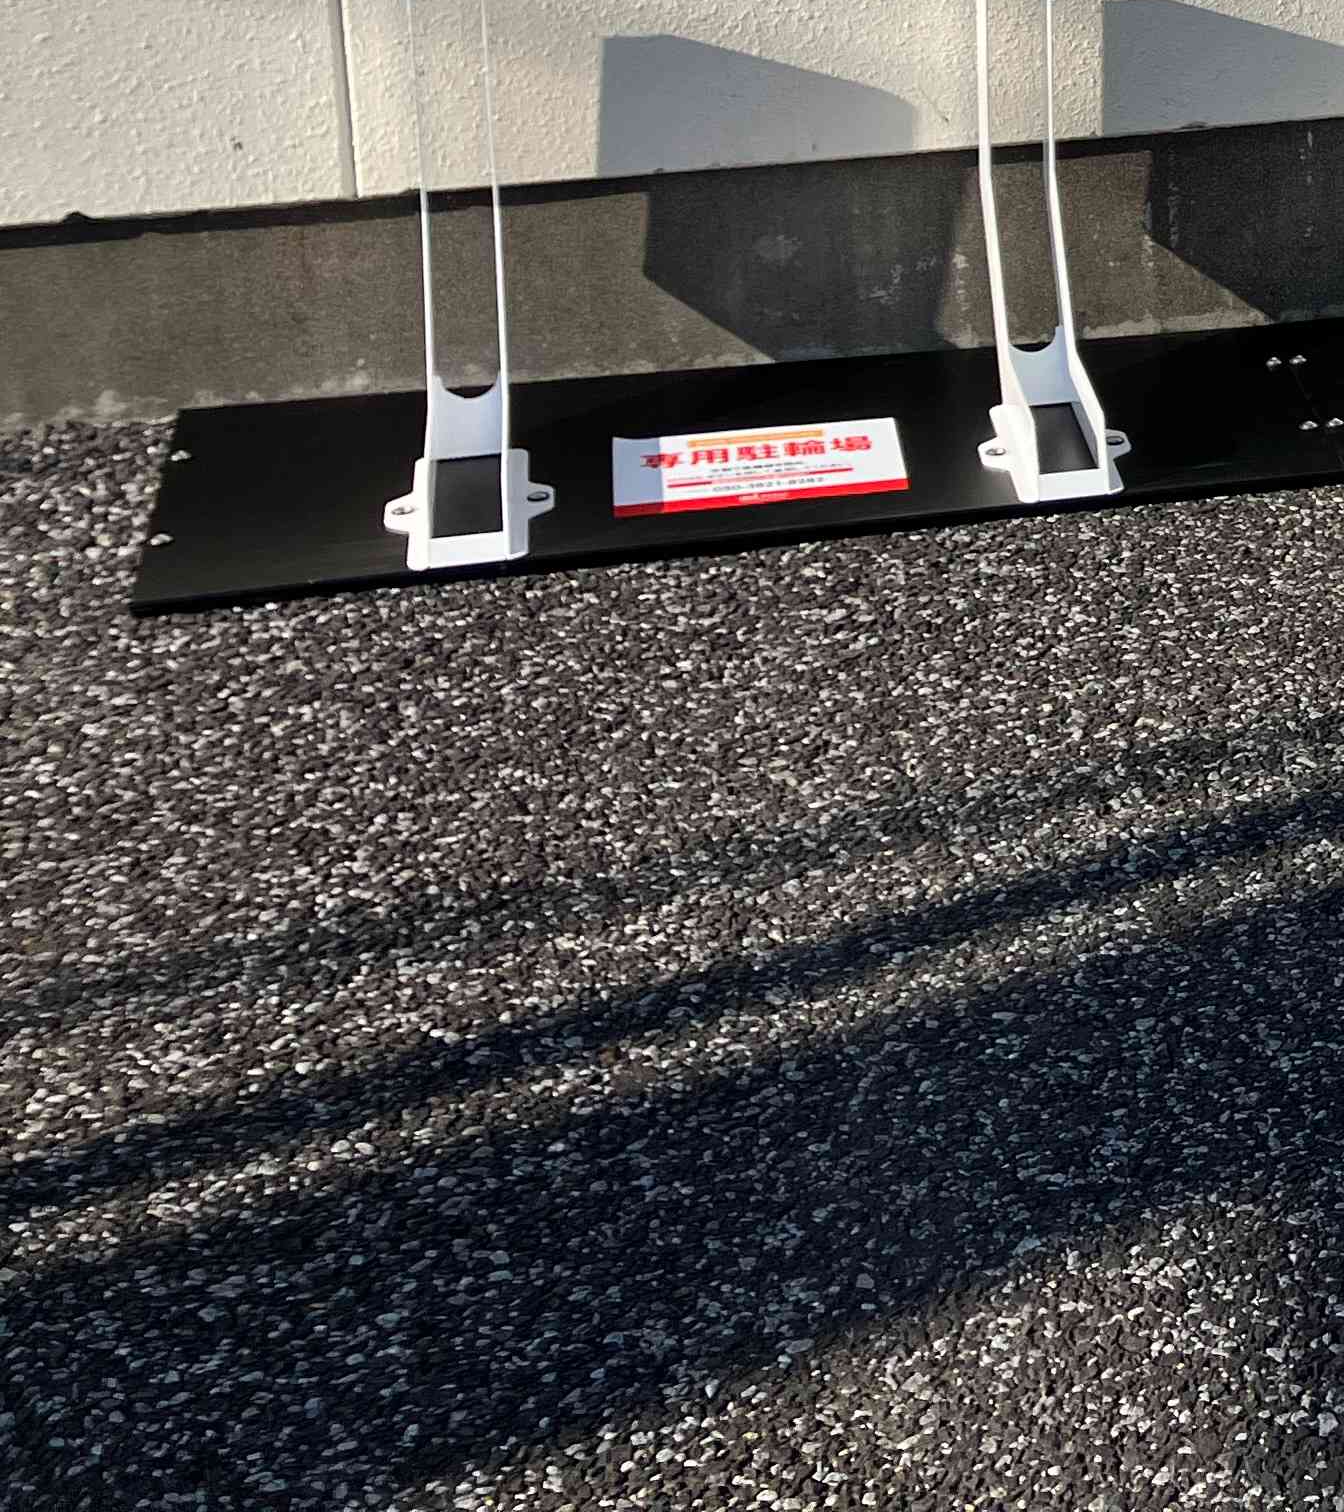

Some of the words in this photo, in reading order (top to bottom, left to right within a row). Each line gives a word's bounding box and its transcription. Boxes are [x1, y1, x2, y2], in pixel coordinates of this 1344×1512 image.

[640, 435, 873, 469] 専用駐輪場
